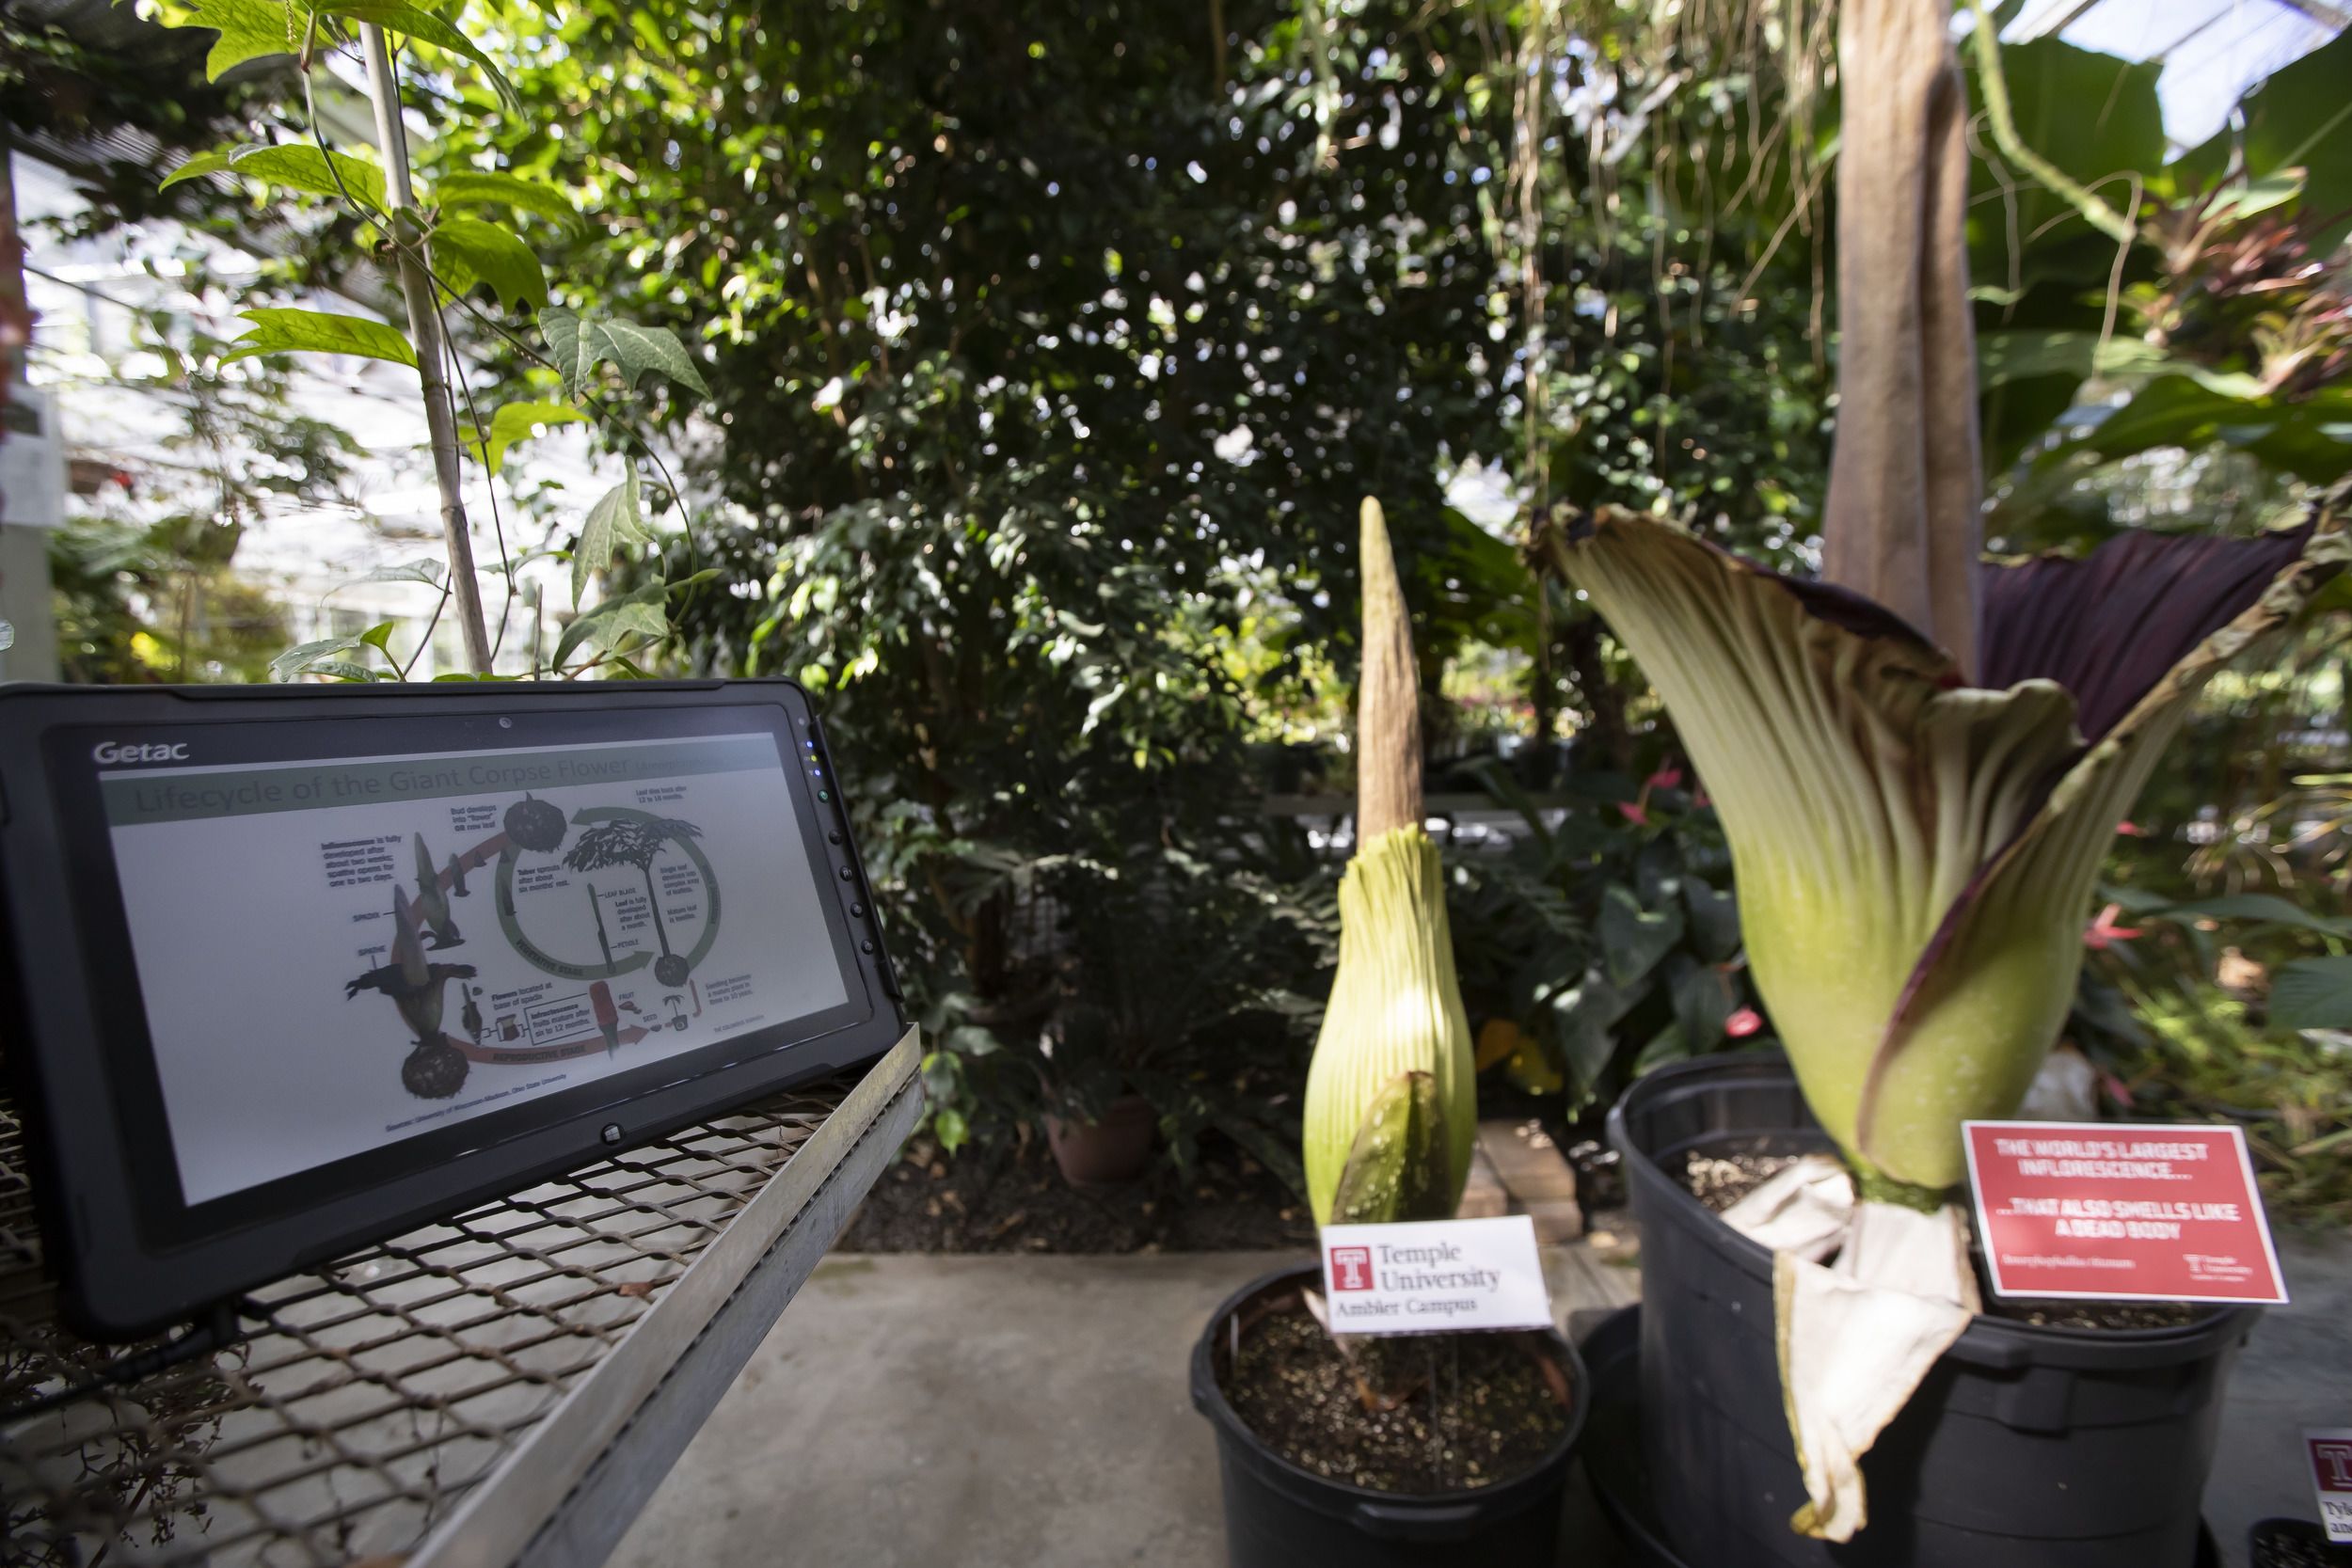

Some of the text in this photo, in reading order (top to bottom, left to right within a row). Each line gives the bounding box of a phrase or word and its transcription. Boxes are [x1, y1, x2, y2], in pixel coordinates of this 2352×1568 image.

[93, 740, 190, 764] Getac
[136, 781, 282, 812] Lifecycle
[294, 776, 324, 800] of
[330, 773, 379, 797] the
[389, 768, 462, 793] Giant
[469, 765, 551, 792] Corpse
[558, 757, 629, 779] Flower
[321, 839, 375, 850] Inflorescence
[324, 848, 365, 860] developed
[326, 859, 349, 869] about
[326, 869, 355, 879] spathe
[358, 865, 382, 874] opens
[373, 873, 394, 881] days.
[605, 888, 636, 898] LEAF BLADE
[617, 904, 647, 914] developed
[634, 911, 650, 920] about
[627, 921, 647, 929] month.
[516, 938, 583, 976] VEGETATIVE STAGE
[491, 991, 517, 1001] Flowers
[518, 984, 544, 995] located
[619, 991, 634, 1001] FRUIT
[494, 1002, 511, 1010] base
[520, 993, 543, 1004] spadix
[531, 1004, 579, 1020] Infructescence
[532, 1008, 590, 1028] fruits mature after
[643, 1014, 658, 1022] SEED
[564, 1019, 591, 1029] months.
[493, 1045, 587, 1062] REPRODUCTIVE STAGE
[415, 1111, 445, 1122] University
[526, 1082, 540, 1090] State
[541, 1074, 566, 1085] University
[1993, 1138, 2032, 1157] THE
[2118, 1142, 2209, 1161] LARGEST
[2060, 1199, 2110, 1219] ALSO
[2111, 1200, 2191, 1220] SMELLS
[2190, 1203, 2242, 1222] LIKE
[2055, 1219, 2182, 1241] A DEAD BODY
[1377, 1241, 1461, 1267] Temple
[1334, 1249, 1368, 1290] T
[1380, 1266, 1501, 1292] University
[1336, 1298, 1477, 1317] Ambler Campus
